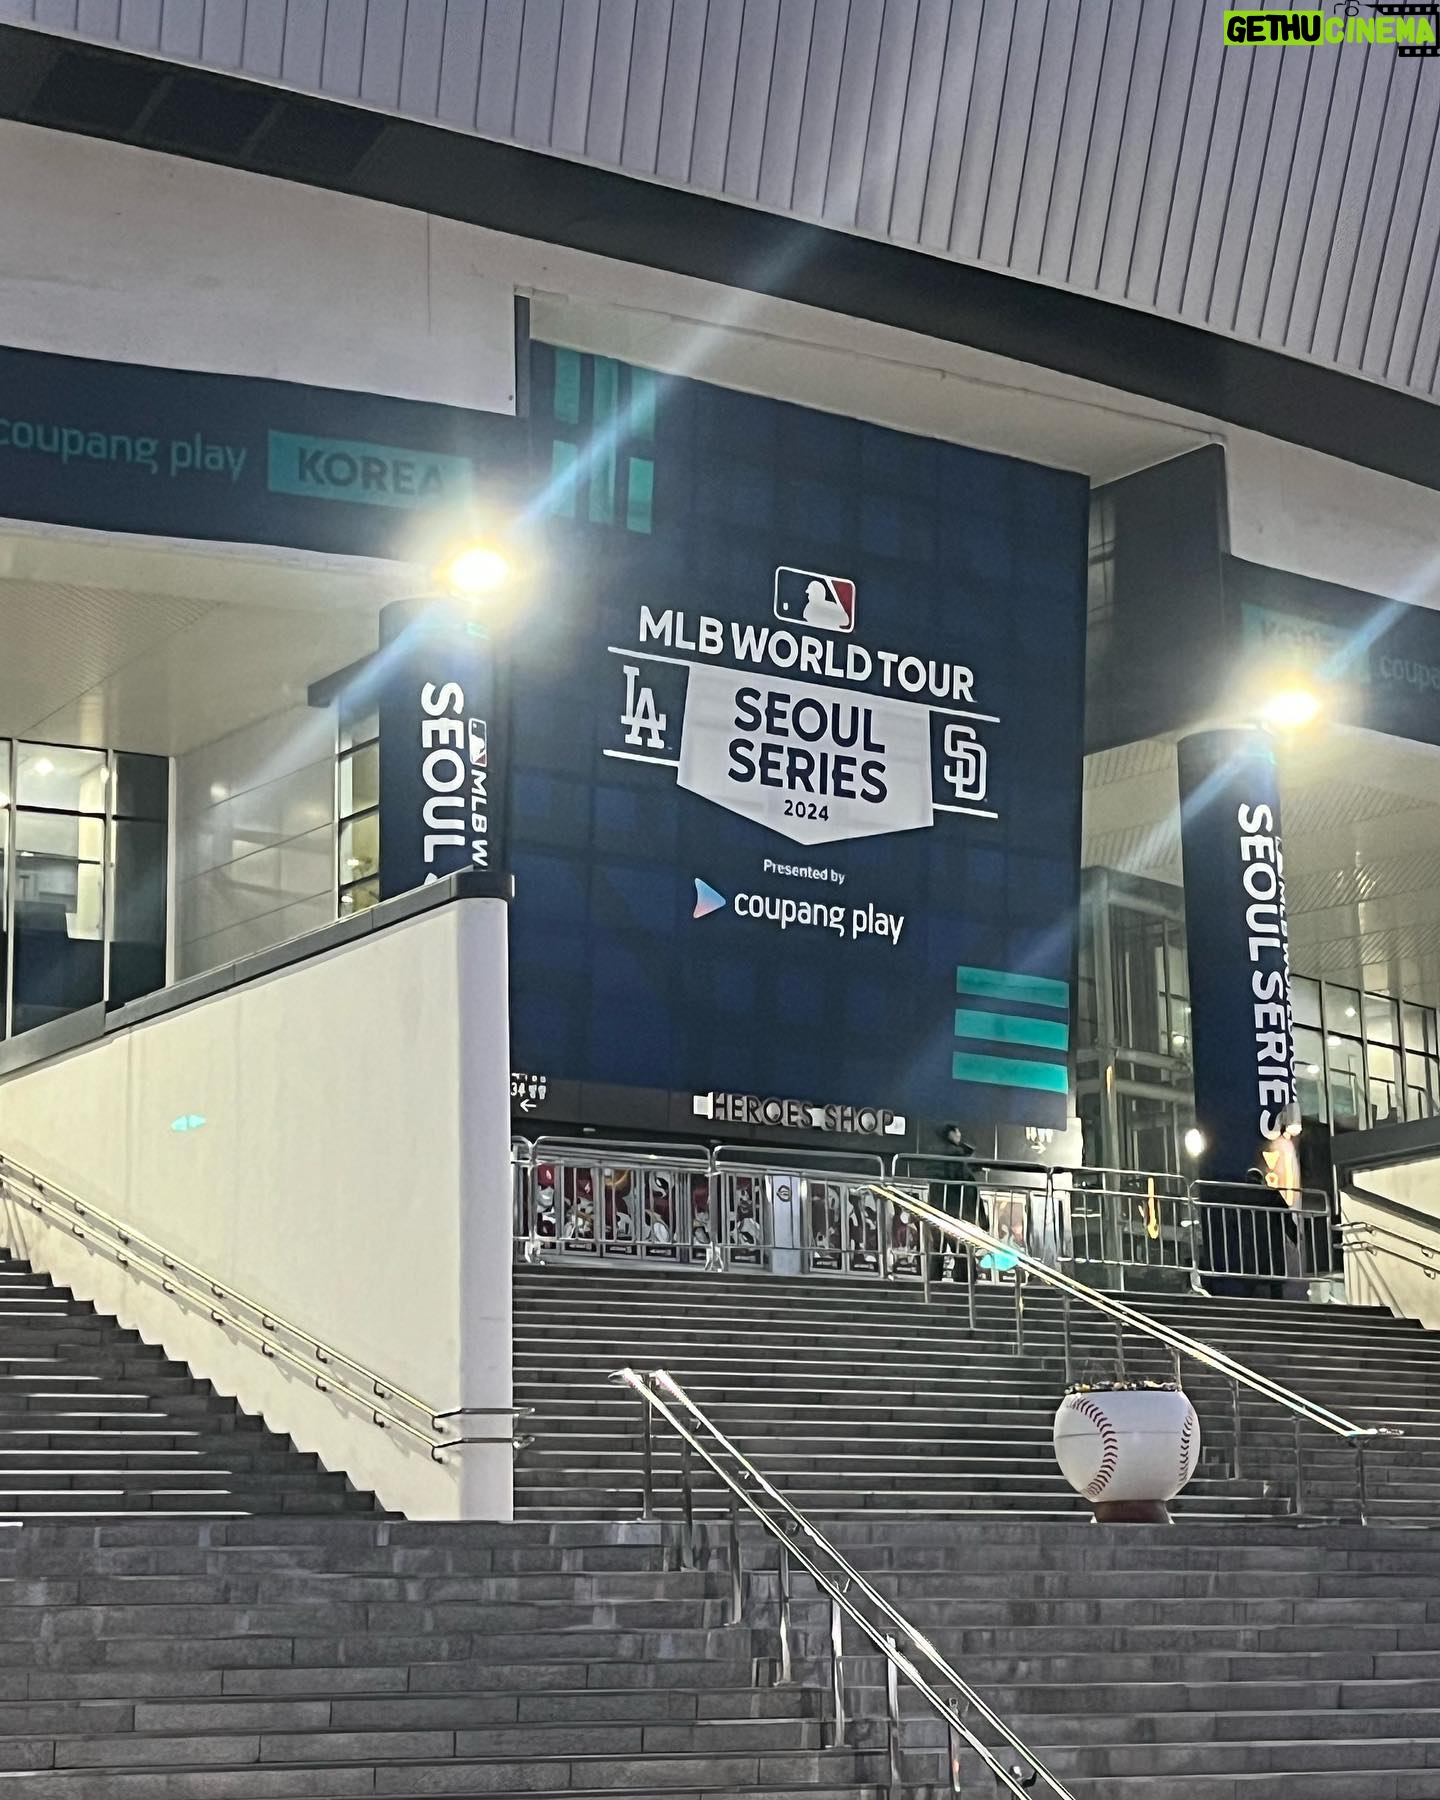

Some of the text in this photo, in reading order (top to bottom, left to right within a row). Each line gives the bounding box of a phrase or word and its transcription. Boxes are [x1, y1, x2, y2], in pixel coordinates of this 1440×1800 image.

[0, 418, 247, 482] coupang play
[298, 446, 444, 496] KOREA
[639, 605, 978, 702] MLB WORLD TOUR
[620, 665, 667, 749] LA
[734, 687, 886, 754] SEOUL
[421, 682, 465, 863] SEOUL
[727, 737, 888, 803] SERIES
[943, 723, 987, 801] SD
[471, 769, 487, 833] MLB
[783, 799, 829, 822] 2024
[763, 858, 845, 885] Presented by
[734, 892, 904, 945] coupang play
[1238, 803, 1289, 1141] SEOUL SERIES
[710, 1092, 894, 1136] HEROES SHOP
